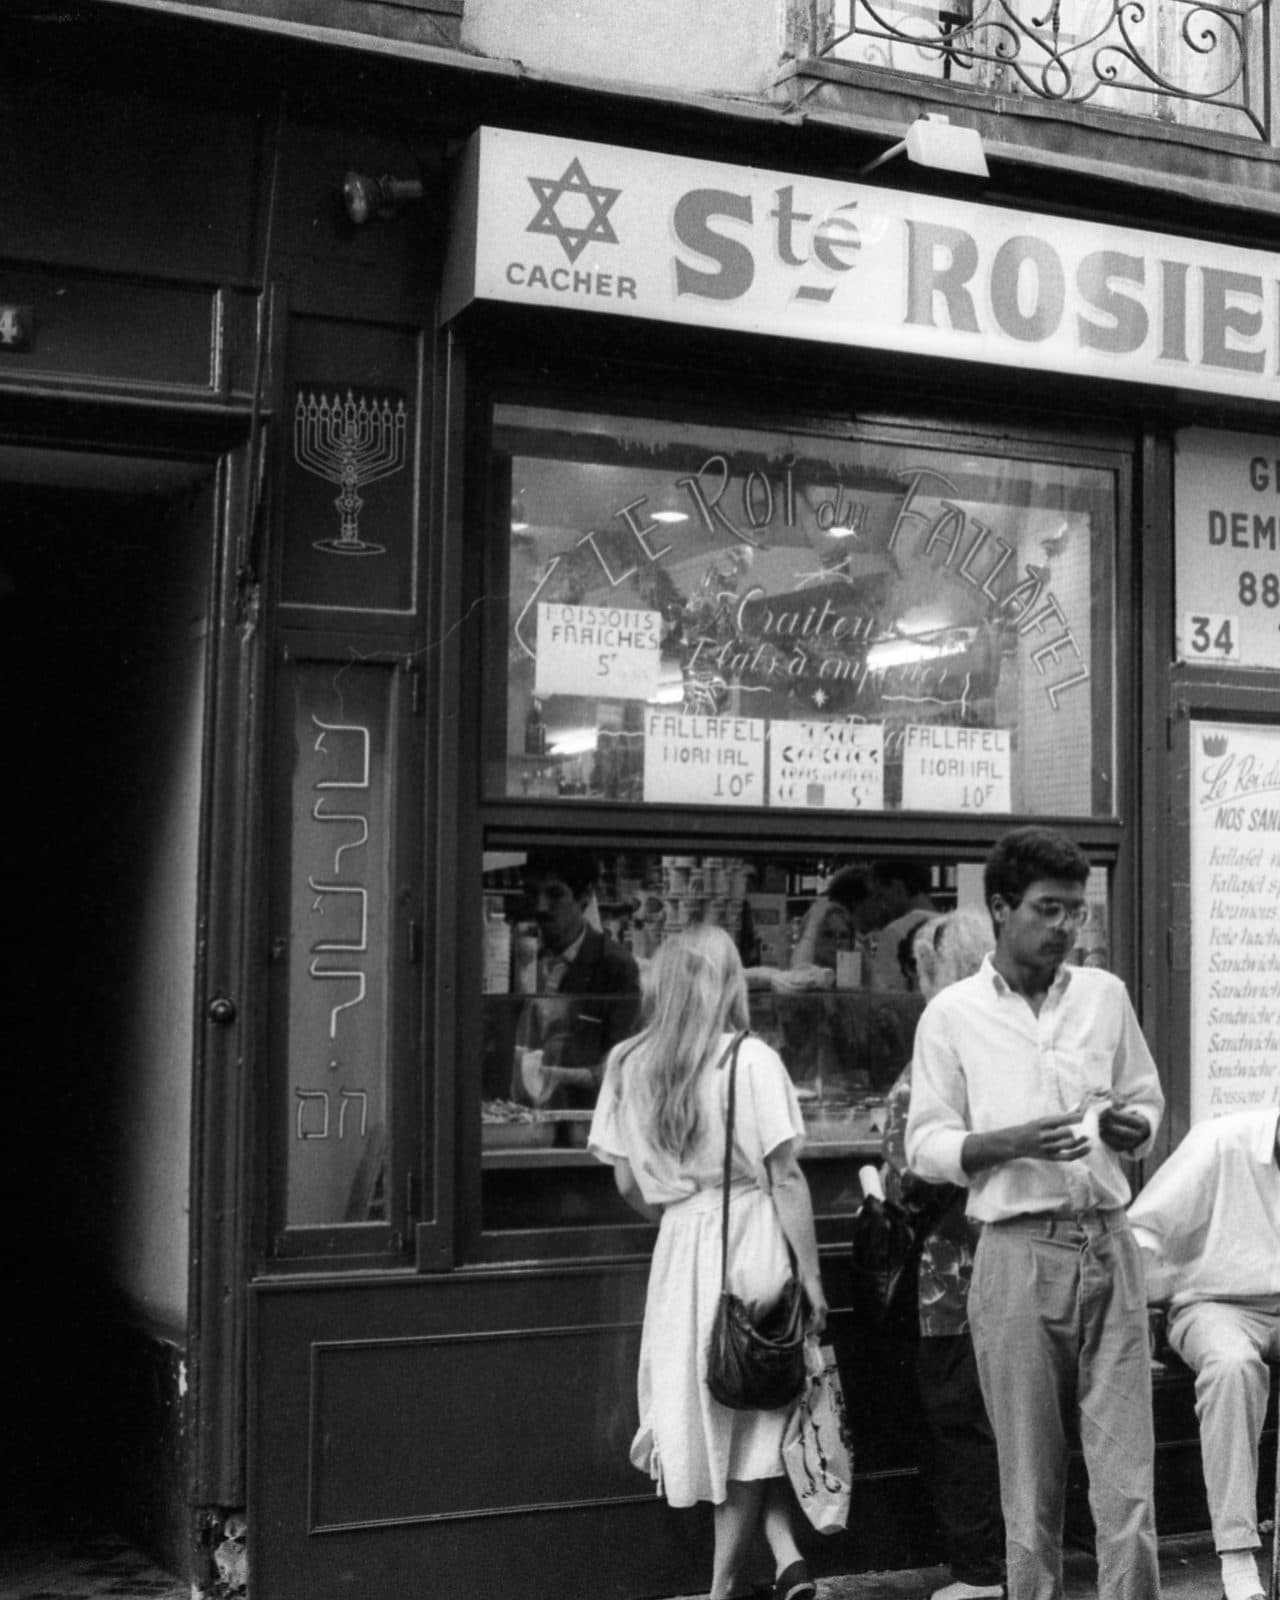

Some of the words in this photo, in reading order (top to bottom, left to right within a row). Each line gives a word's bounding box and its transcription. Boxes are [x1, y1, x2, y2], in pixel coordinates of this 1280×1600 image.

[505, 261, 638, 301] CACHER
[576, 494, 673, 586] LE
[889, 466, 1091, 710] FALLAFEL
[552, 624, 658, 650] FRAICHES
[1191, 616, 1234, 655] 34
[649, 715, 762, 743] FALLAFEL
[907, 727, 1006, 752] FALLAFEL
[663, 745, 750, 767] NORMAL
[920, 757, 1004, 779] NORMAL
[712, 772, 756, 798] 10F
[1200, 752, 1236, 804] Le
[1234, 754, 1264, 792] Roi
[1214, 807, 1246, 831] NOS
